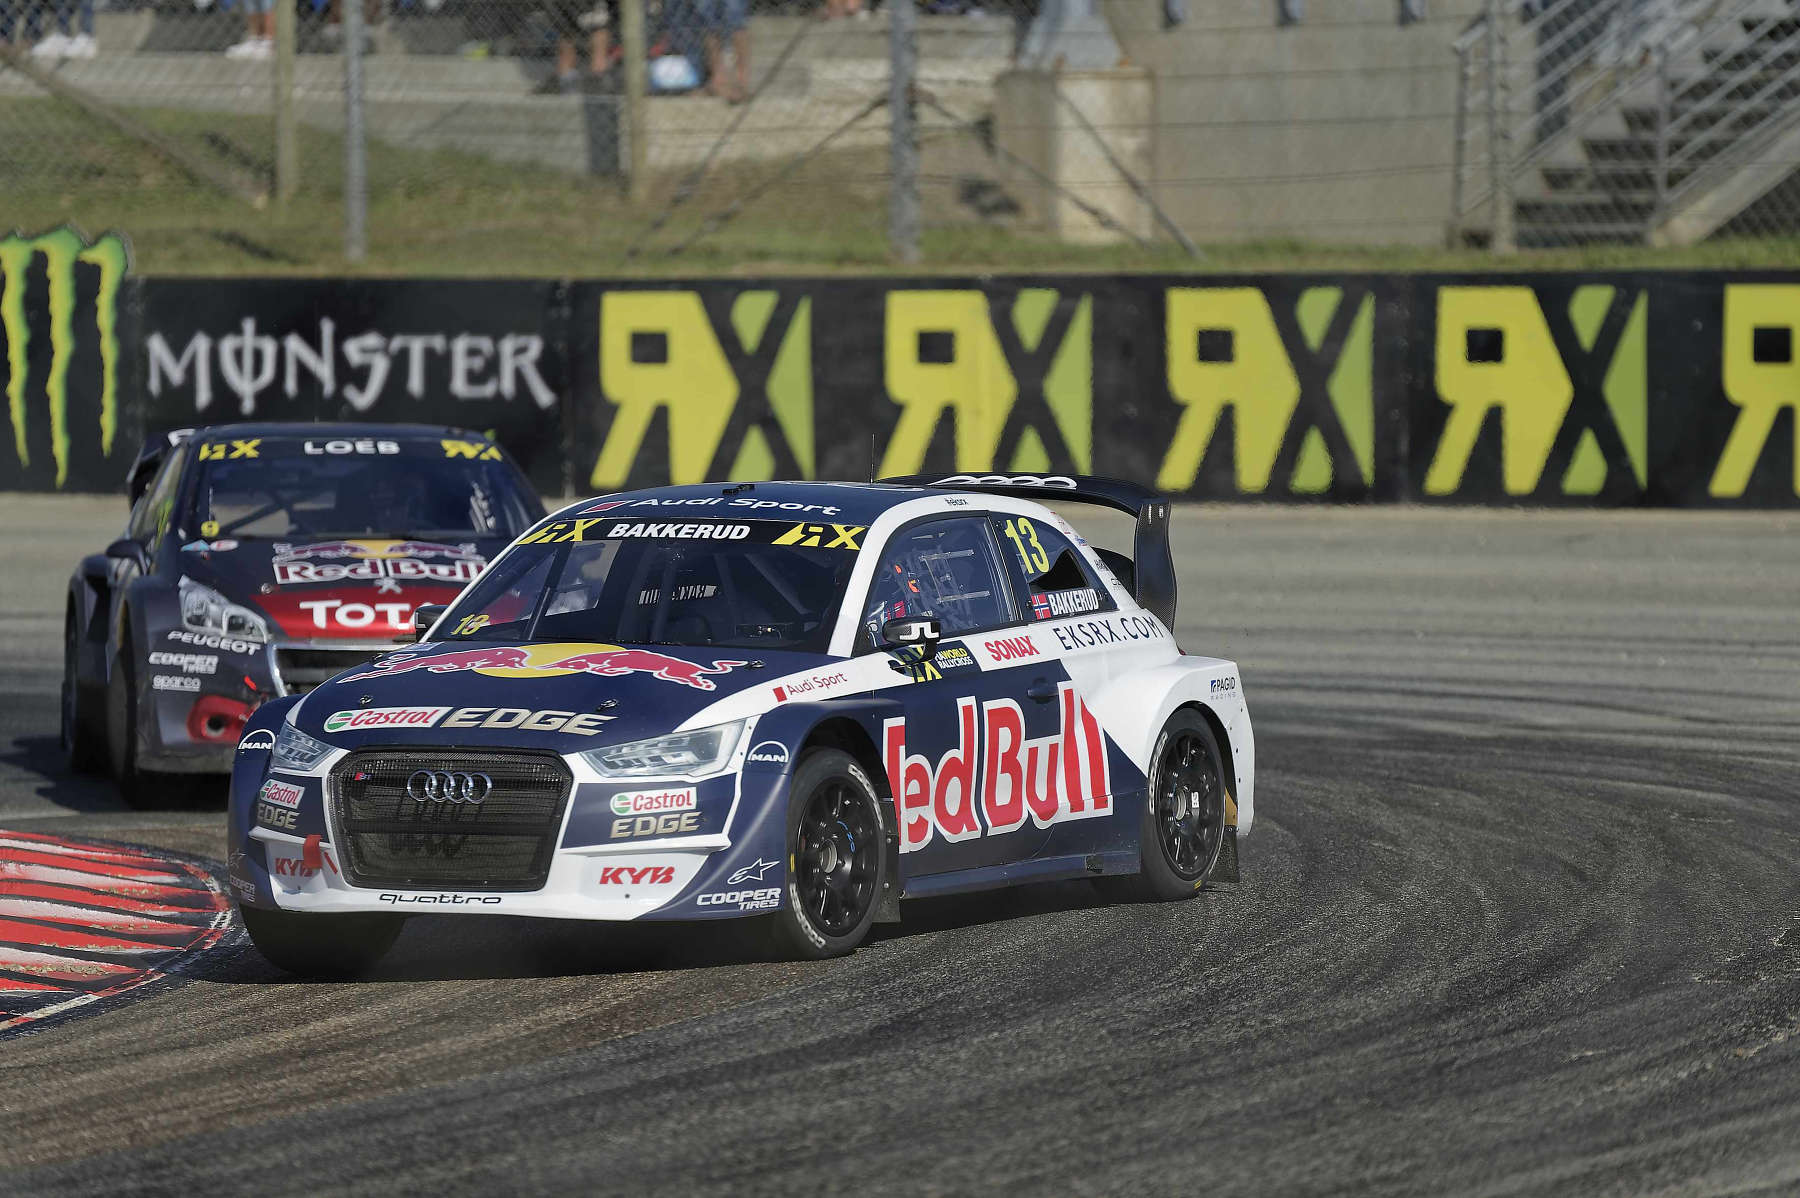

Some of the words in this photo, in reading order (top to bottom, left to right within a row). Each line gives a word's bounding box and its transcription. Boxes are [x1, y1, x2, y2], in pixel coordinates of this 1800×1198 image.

[146, 317, 557, 415] MONSTER
[304, 440, 400, 454] LOEB
[630, 498, 722, 507] Audi
[728, 498, 842, 516] Sport
[607, 523, 751, 540] BAKKERUD
[1004, 517, 1050, 575] 13
[273, 558, 384, 585] Red
[1048, 588, 1100, 616] BAKKERUD
[450, 614, 490, 636] 13
[1052, 616, 1164, 651] EKSRX.COM
[168, 631, 261, 655] PEUGEOT
[984, 636, 1041, 662] SONAX
[149, 651, 219, 667] COOPER
[937, 656, 974, 669] RALLYCROSS
[152, 675, 201, 691] sparco
[786, 679, 815, 696] Audi
[812, 673, 848, 689] Sport
[350, 708, 440, 727] Castrol
[440, 707, 619, 736] EDGE
[981, 681, 1114, 837] Bull
[266, 783, 301, 806] Castrol
[633, 790, 693, 812] Castrol
[257, 803, 300, 830] EDGE
[610, 811, 702, 839] EDGE
[600, 866, 675, 885] KYB
[379, 892, 502, 905] quattro
[696, 887, 782, 906] COOPER
[738, 899, 780, 911] TIRES
